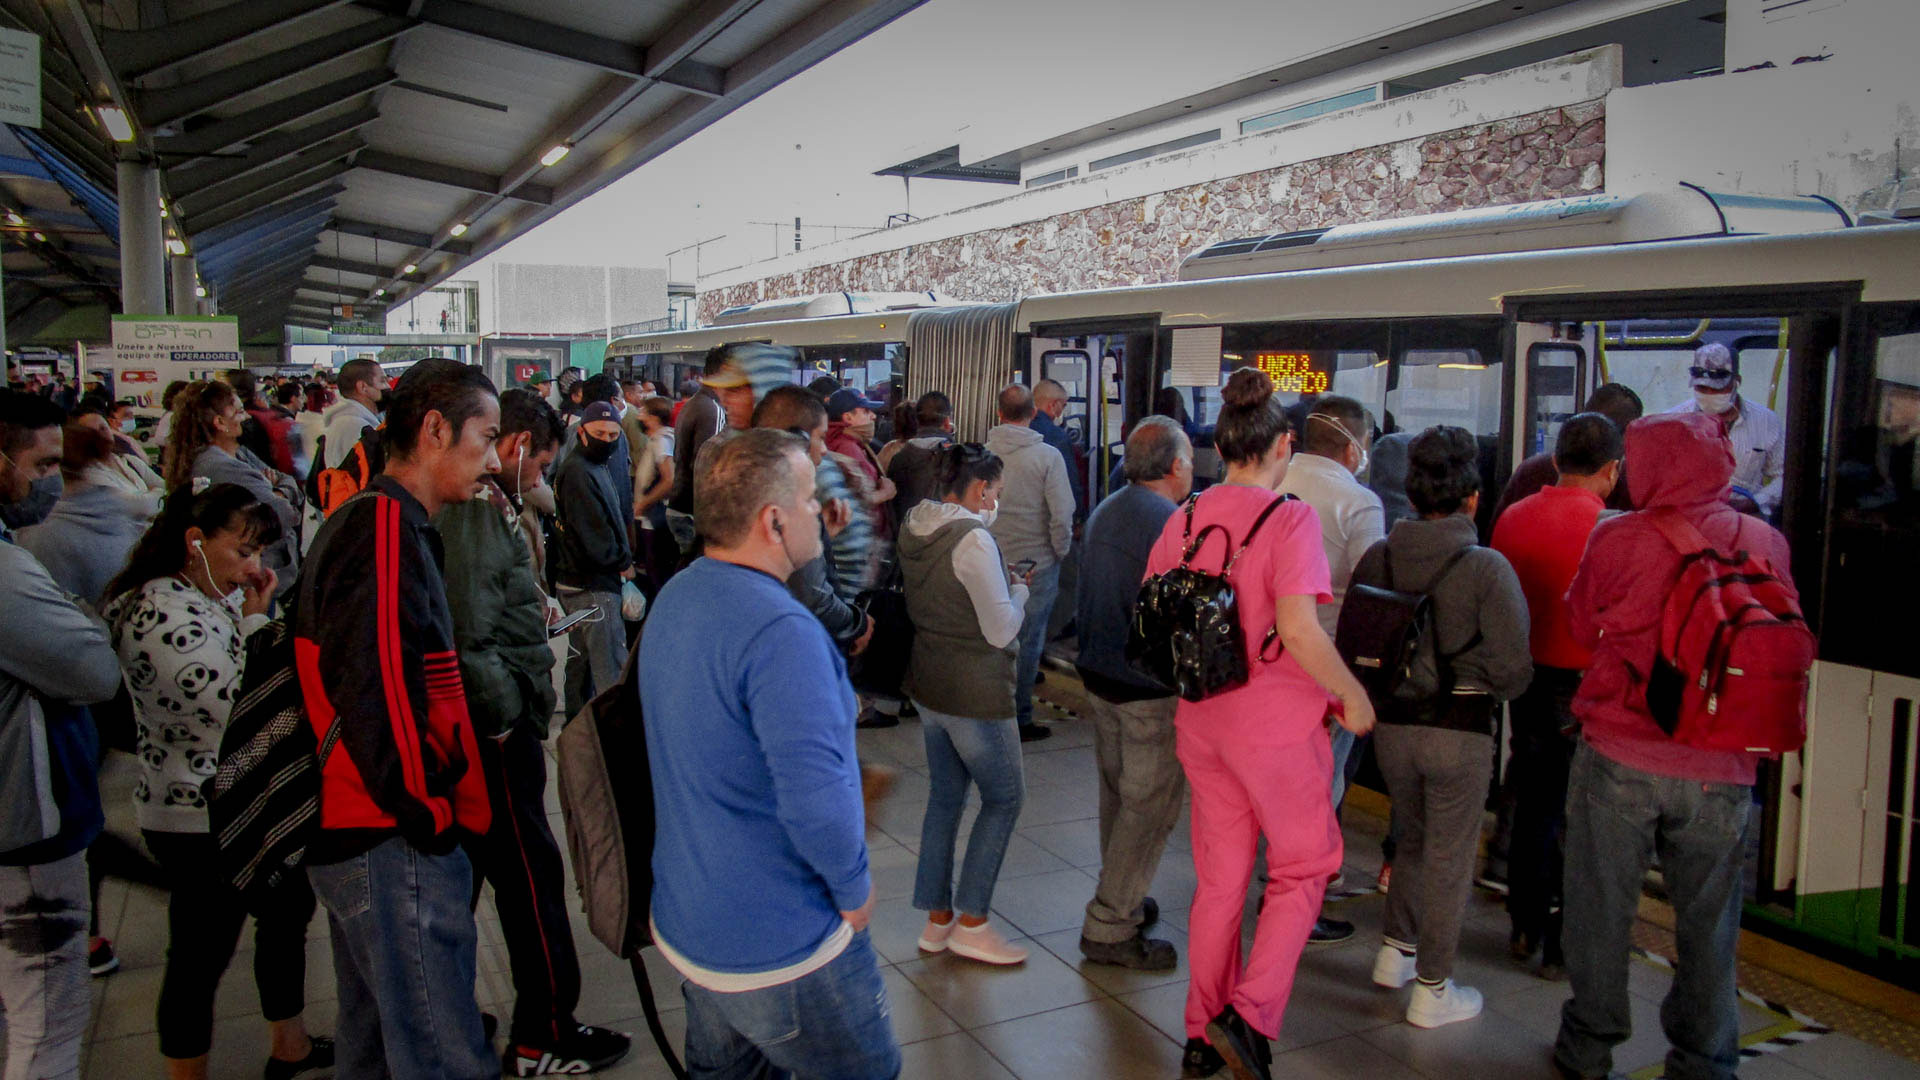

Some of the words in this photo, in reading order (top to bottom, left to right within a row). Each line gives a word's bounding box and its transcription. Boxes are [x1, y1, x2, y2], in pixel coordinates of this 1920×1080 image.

[156, 343, 194, 351] Nuestro
[117, 352, 151, 360] equipo
[174, 352, 237, 360] OPERADORES
[1257, 355, 1297, 372] LINEA
[1300, 355, 1310, 372] 3
